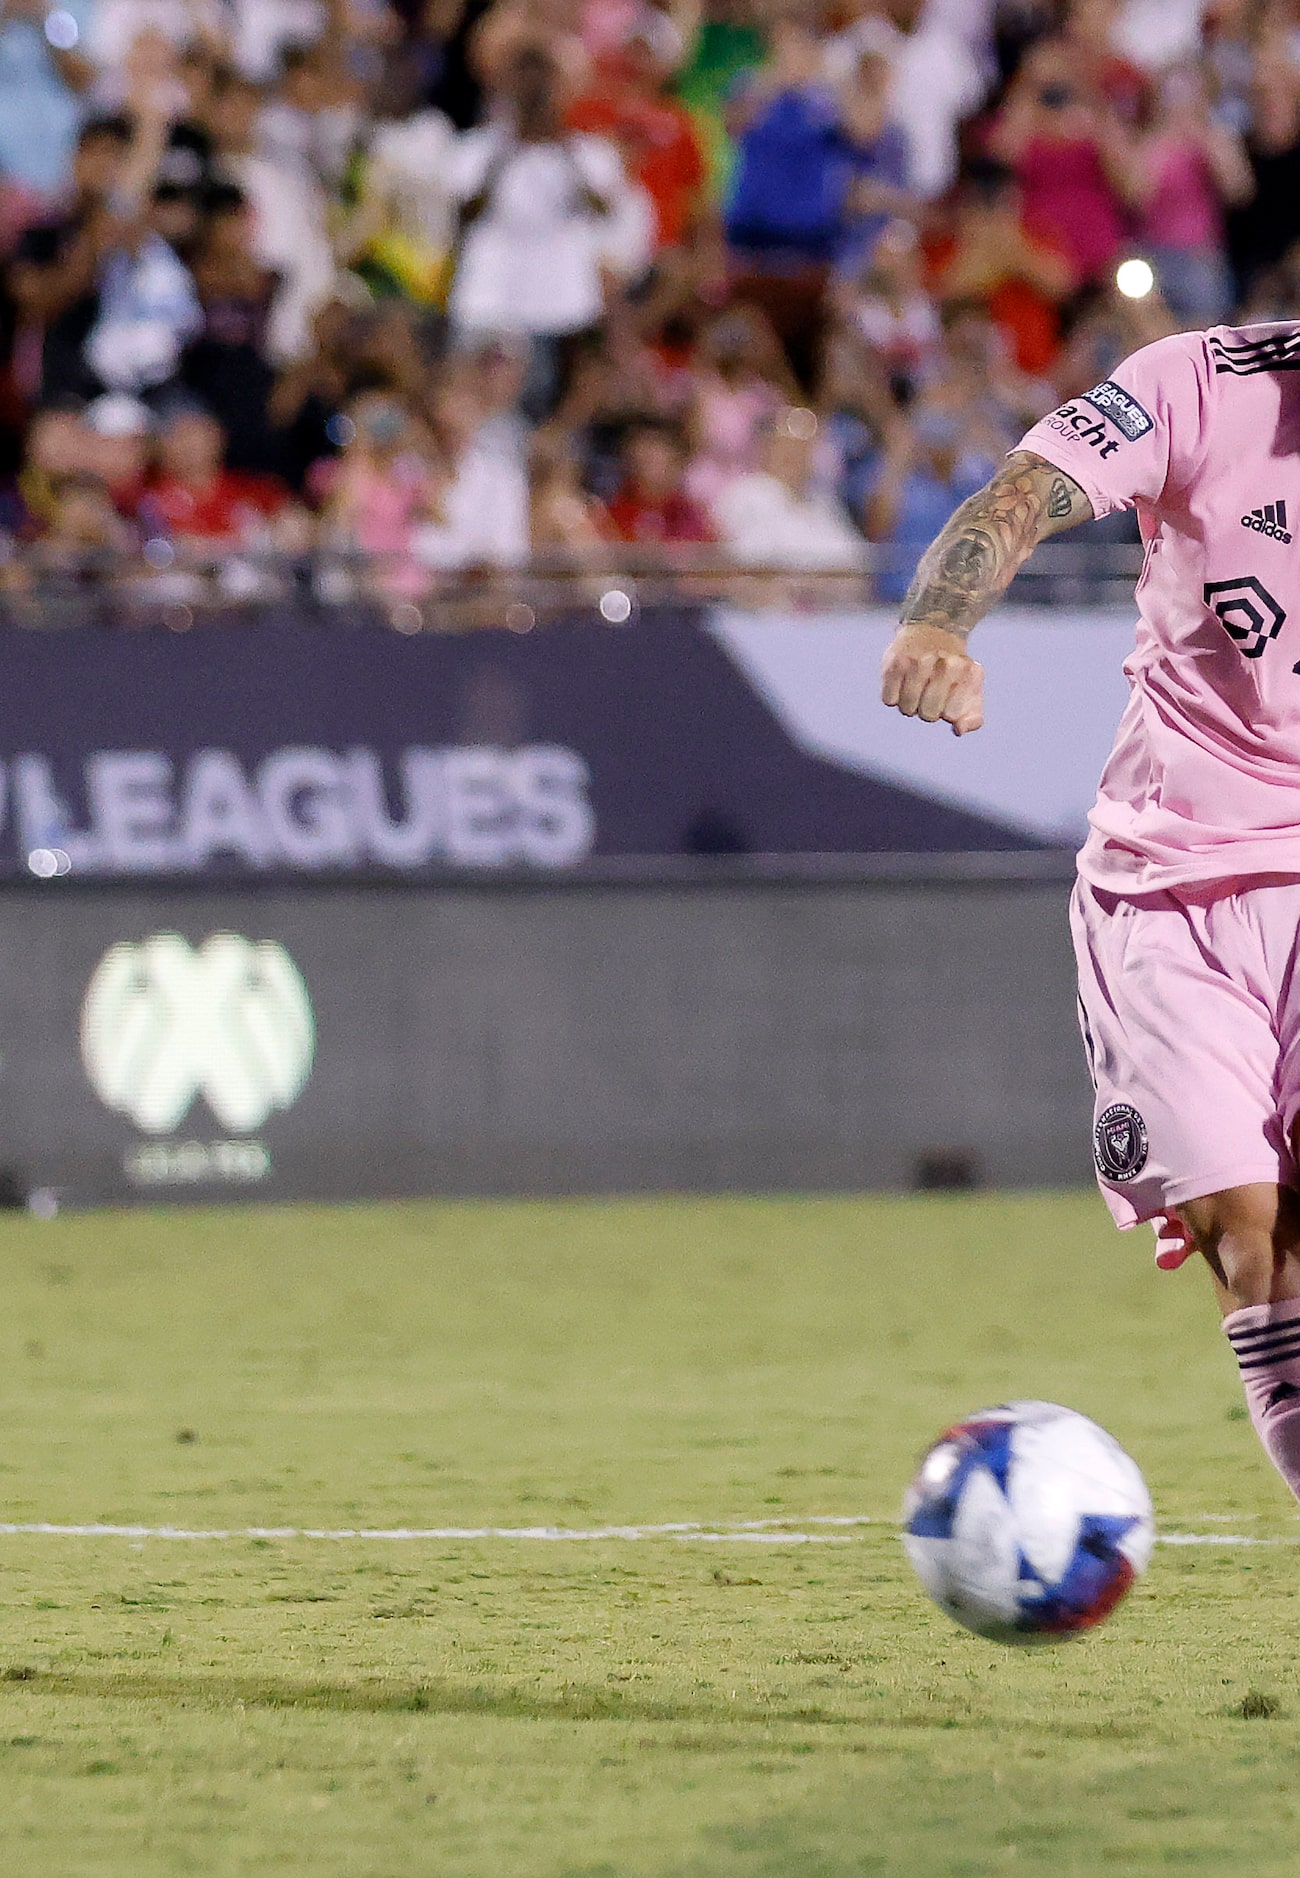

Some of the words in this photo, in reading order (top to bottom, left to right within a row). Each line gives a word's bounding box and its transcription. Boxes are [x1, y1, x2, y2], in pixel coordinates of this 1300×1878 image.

[1055, 405, 1120, 460] acht
[1241, 515, 1293, 545] adidas
[16, 747, 594, 870] LEAGUES
